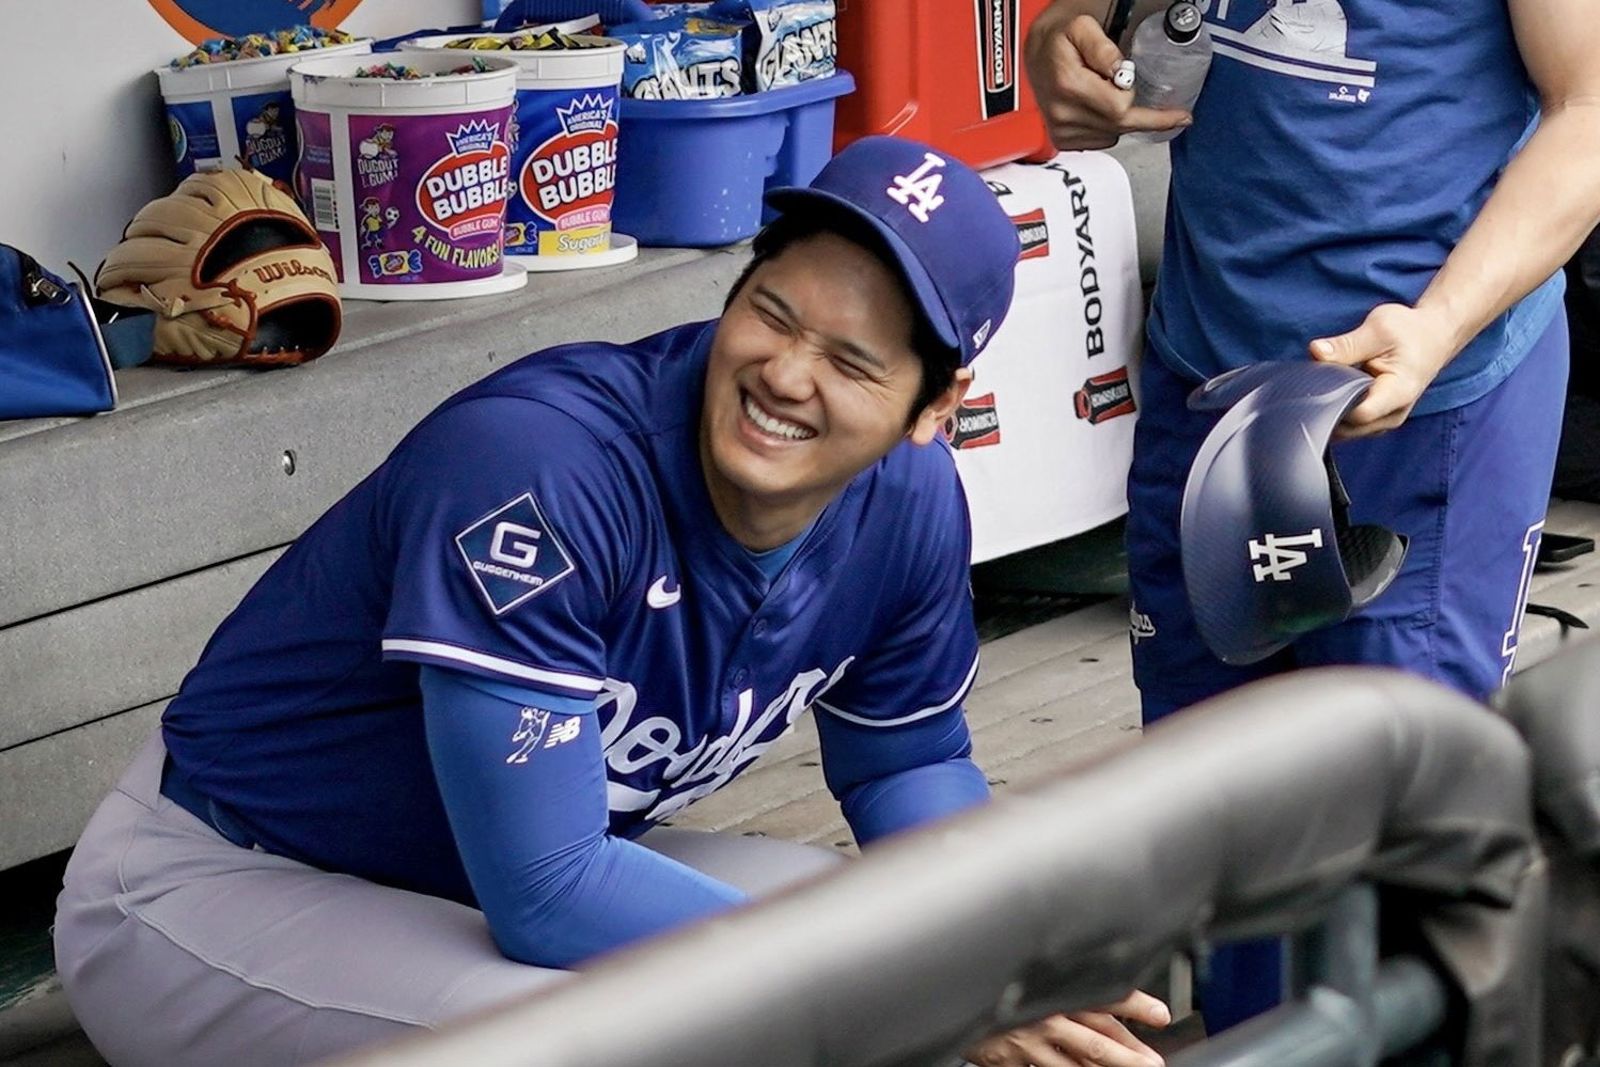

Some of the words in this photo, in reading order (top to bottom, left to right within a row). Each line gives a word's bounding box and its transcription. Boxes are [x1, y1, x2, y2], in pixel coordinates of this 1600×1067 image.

[993, 0, 1004, 85] BODYARM
[426, 155, 507, 198] DUBBLE
[433, 178, 507, 220] BUBBLE
[886, 152, 946, 223] LA
[411, 225, 427, 244] 4
[424, 234, 451, 261] FUN
[1044, 163, 1104, 359] BODYARM
[490, 521, 541, 568] G
[1248, 528, 1323, 583] LA
[473, 560, 544, 586] GUGGENHEIM
